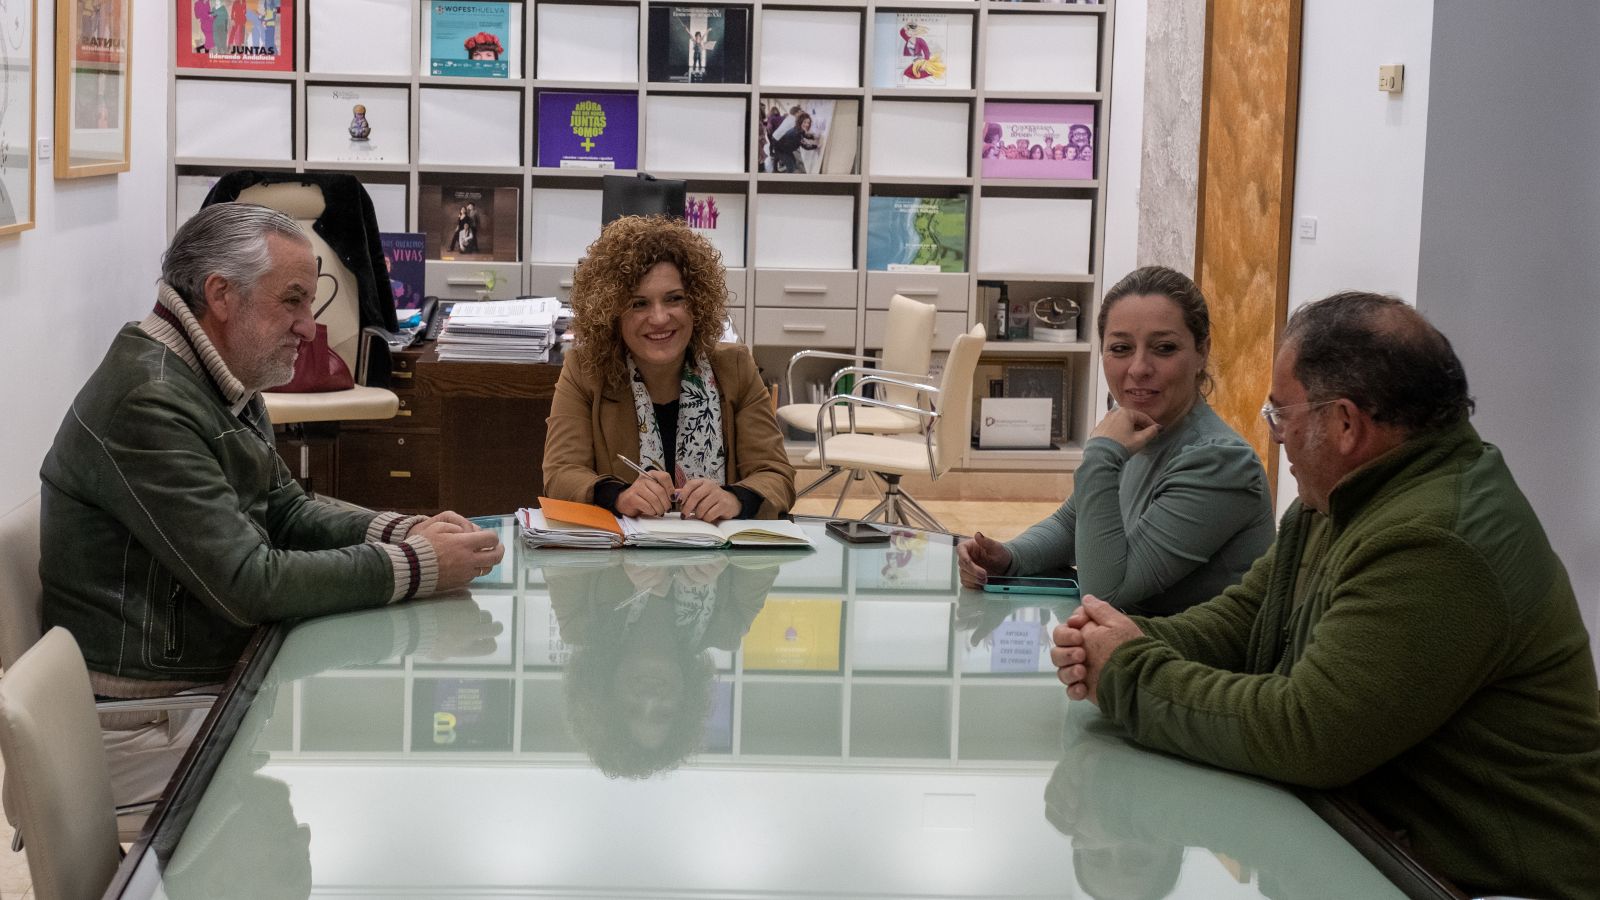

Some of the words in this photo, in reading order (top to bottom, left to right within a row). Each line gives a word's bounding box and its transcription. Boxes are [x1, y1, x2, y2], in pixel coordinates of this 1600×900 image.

[231, 45, 275, 55] JUNTAS
[575, 101, 602, 111] AHORA
[570, 116, 607, 128] JUNTAS
[573, 127, 604, 138] SOMOS
[395, 240, 425, 249] QUEREMOS
[393, 249, 423, 262] VIVAS
